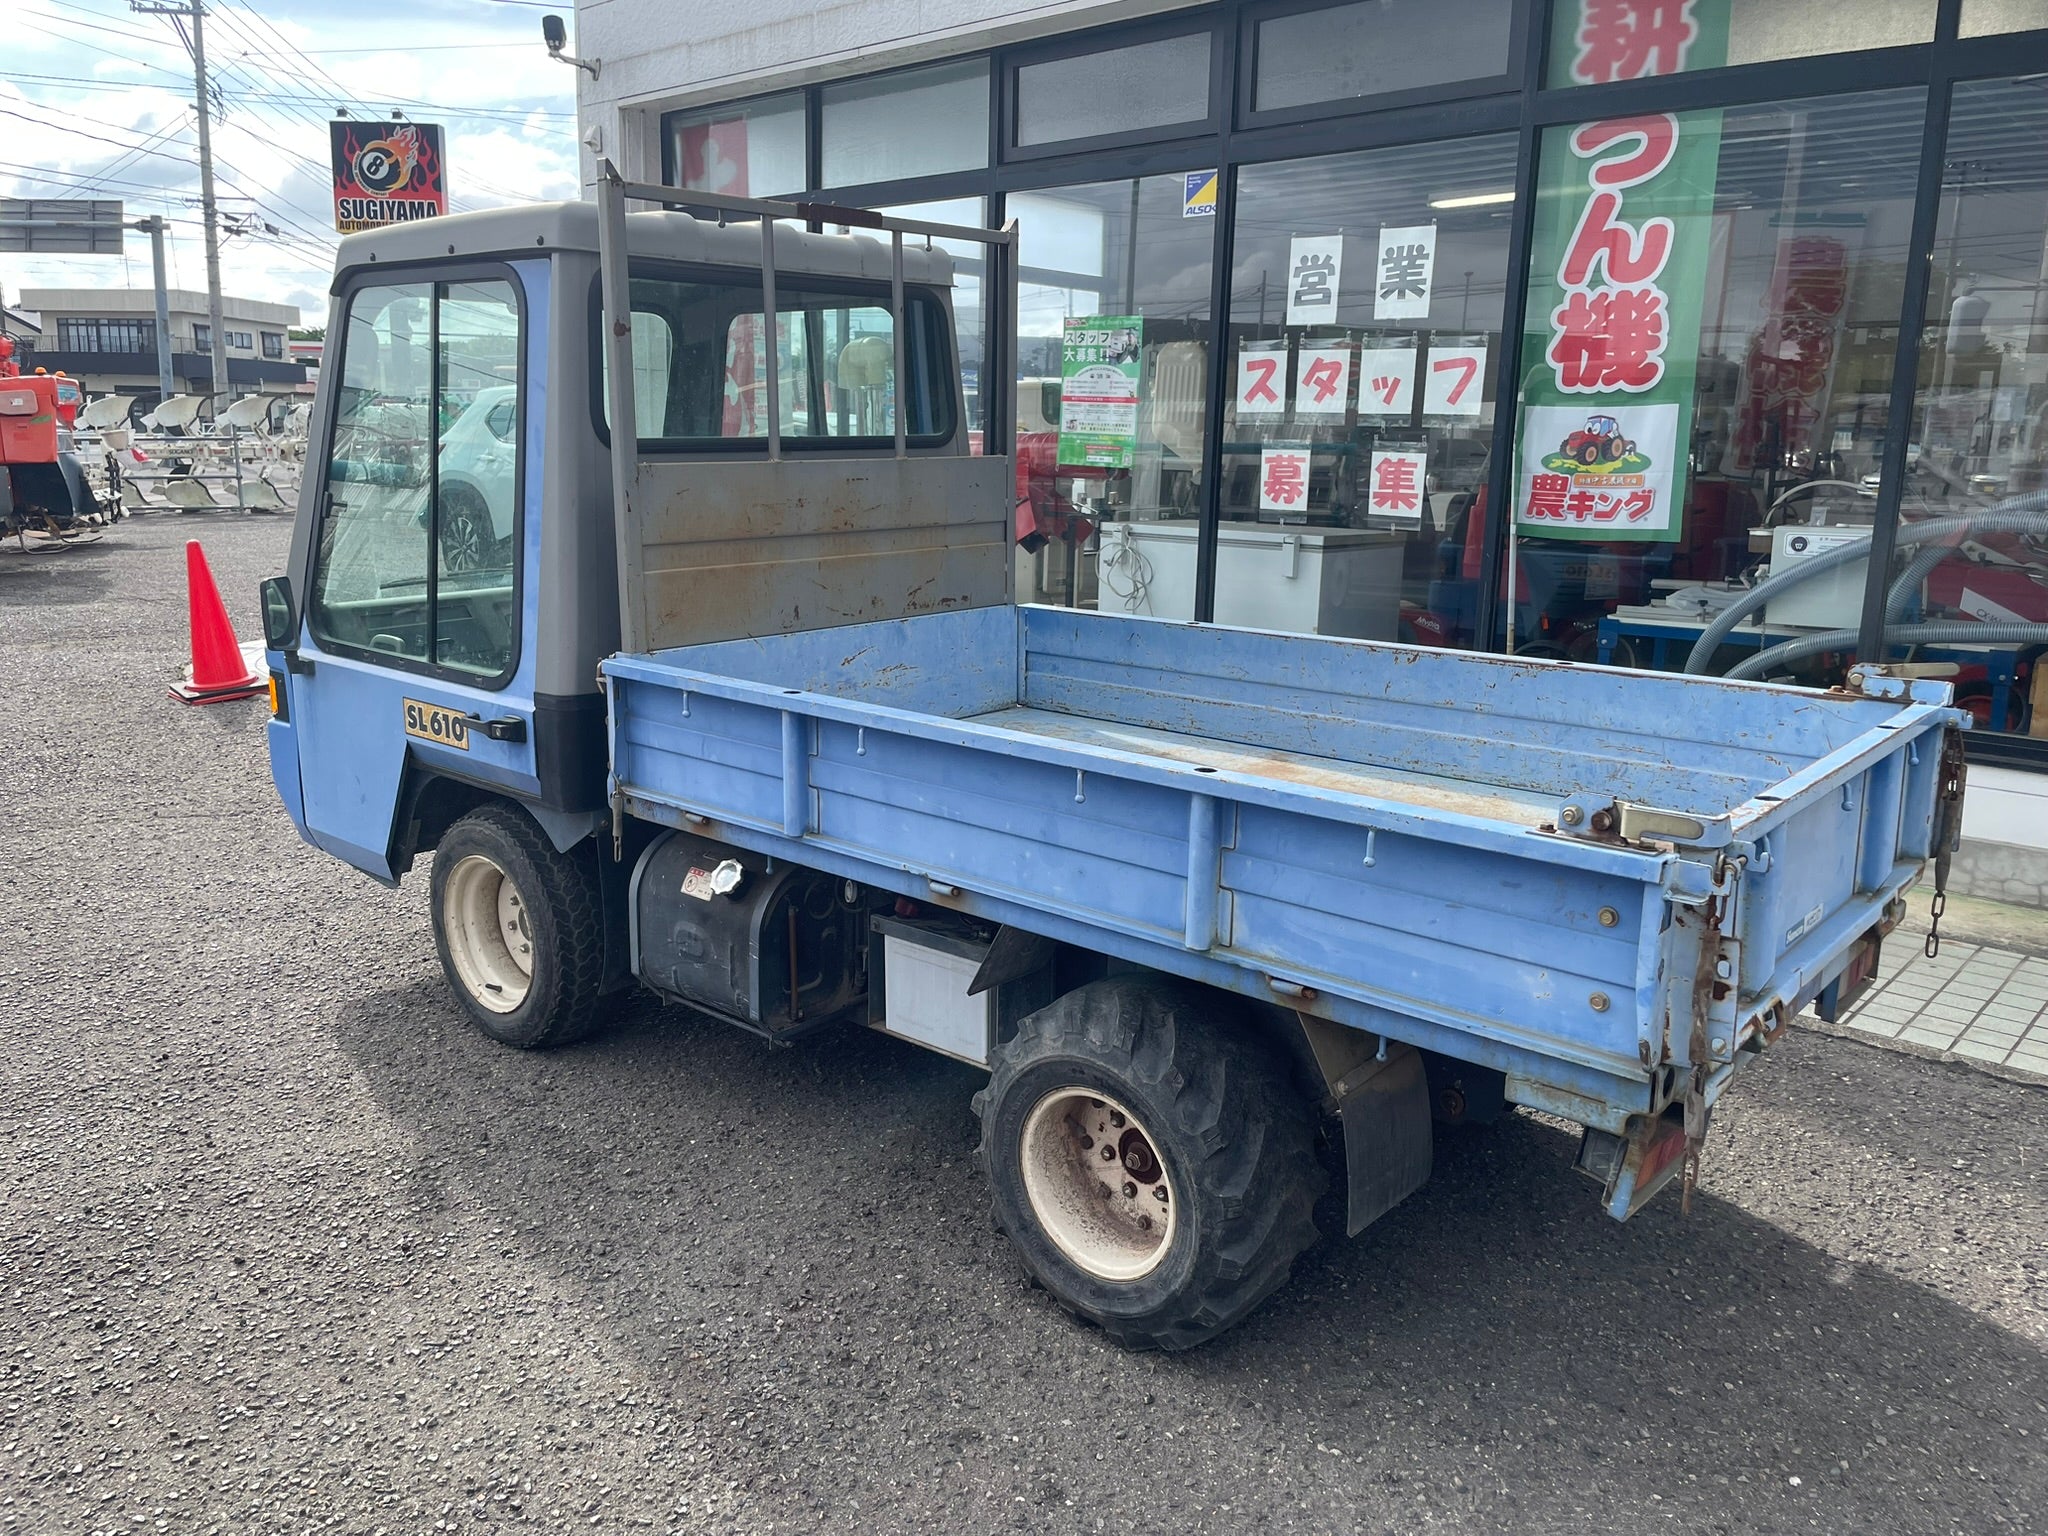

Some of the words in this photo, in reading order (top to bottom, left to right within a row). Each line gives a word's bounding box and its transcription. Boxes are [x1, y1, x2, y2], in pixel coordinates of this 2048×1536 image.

[339, 199, 437, 221] SUGIYAMA
[1294, 244, 1430, 307] 営業
[1065, 332, 1109, 344] スタッフ
[1243, 356, 1478, 406] スタッフ
[1263, 454, 1420, 511] 募集
[1526, 473, 1655, 520] 農キング
